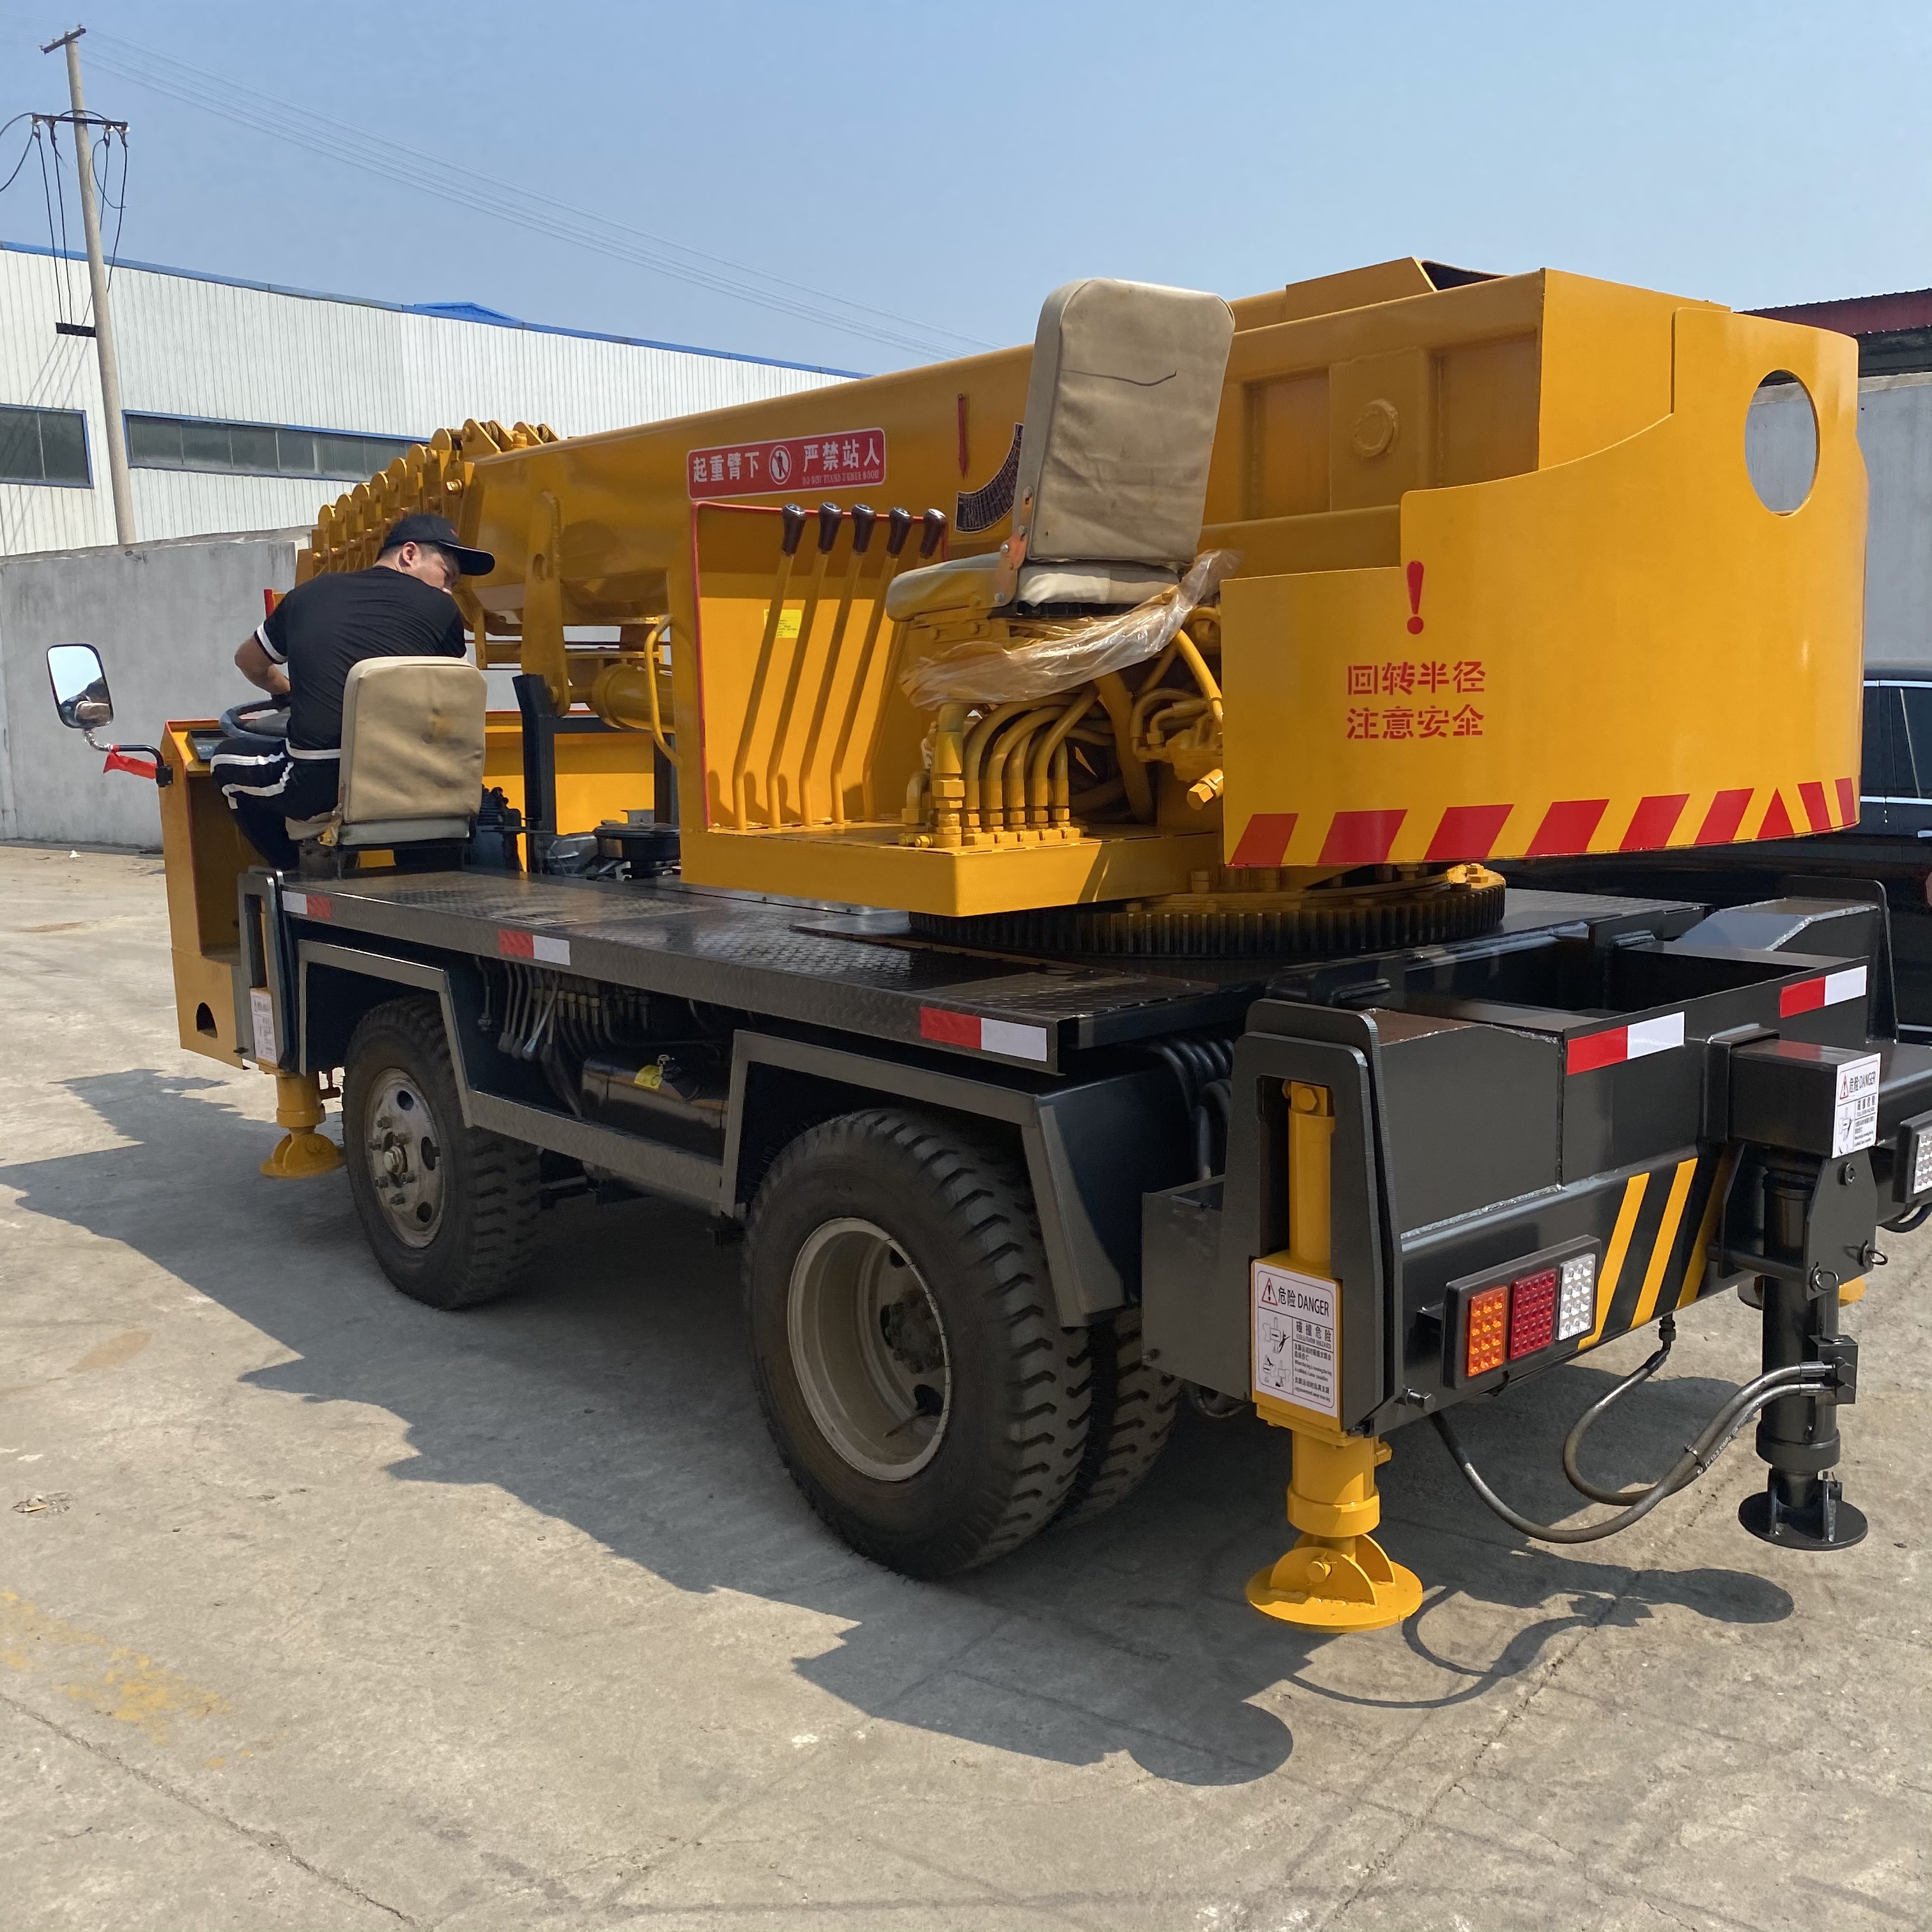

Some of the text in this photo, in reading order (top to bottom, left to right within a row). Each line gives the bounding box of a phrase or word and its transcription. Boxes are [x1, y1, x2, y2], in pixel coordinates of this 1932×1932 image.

[693, 438, 880, 483] 起重臂下 严禁站人
[1347, 661, 1486, 696] 回转半径
[1346, 703, 1484, 740] 注意安全
[1859, 1071, 1876, 1089] DANGER
[1278, 1285, 1330, 1317] 危险 DANGER
